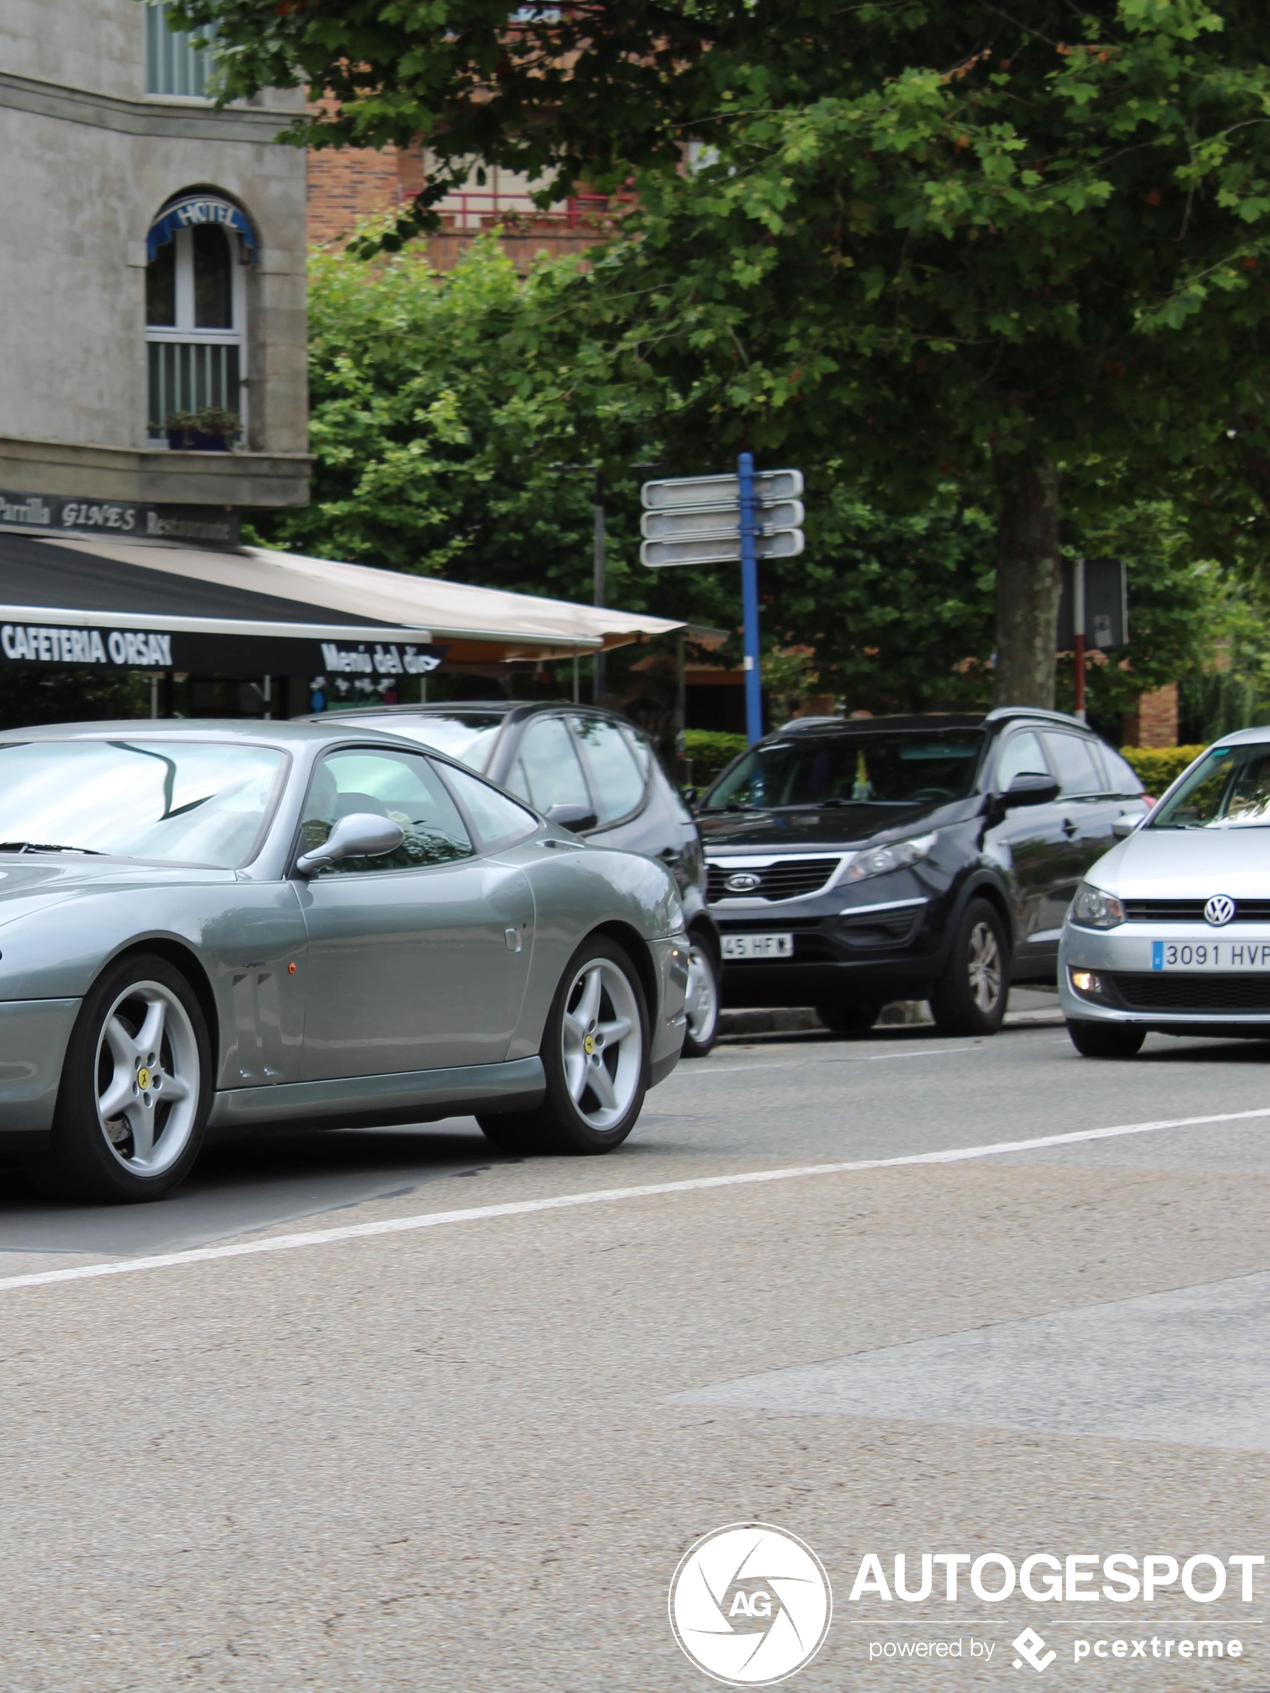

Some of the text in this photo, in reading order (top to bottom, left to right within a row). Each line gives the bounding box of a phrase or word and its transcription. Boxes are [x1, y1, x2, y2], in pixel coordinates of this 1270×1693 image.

[177, 202, 238, 228] HOTEL
[61, 503, 136, 530] GINES
[0, 625, 172, 666] CAFETERIA ORSAY
[724, 938, 747, 956] 45
[1166, 945, 1219, 965] 3091
